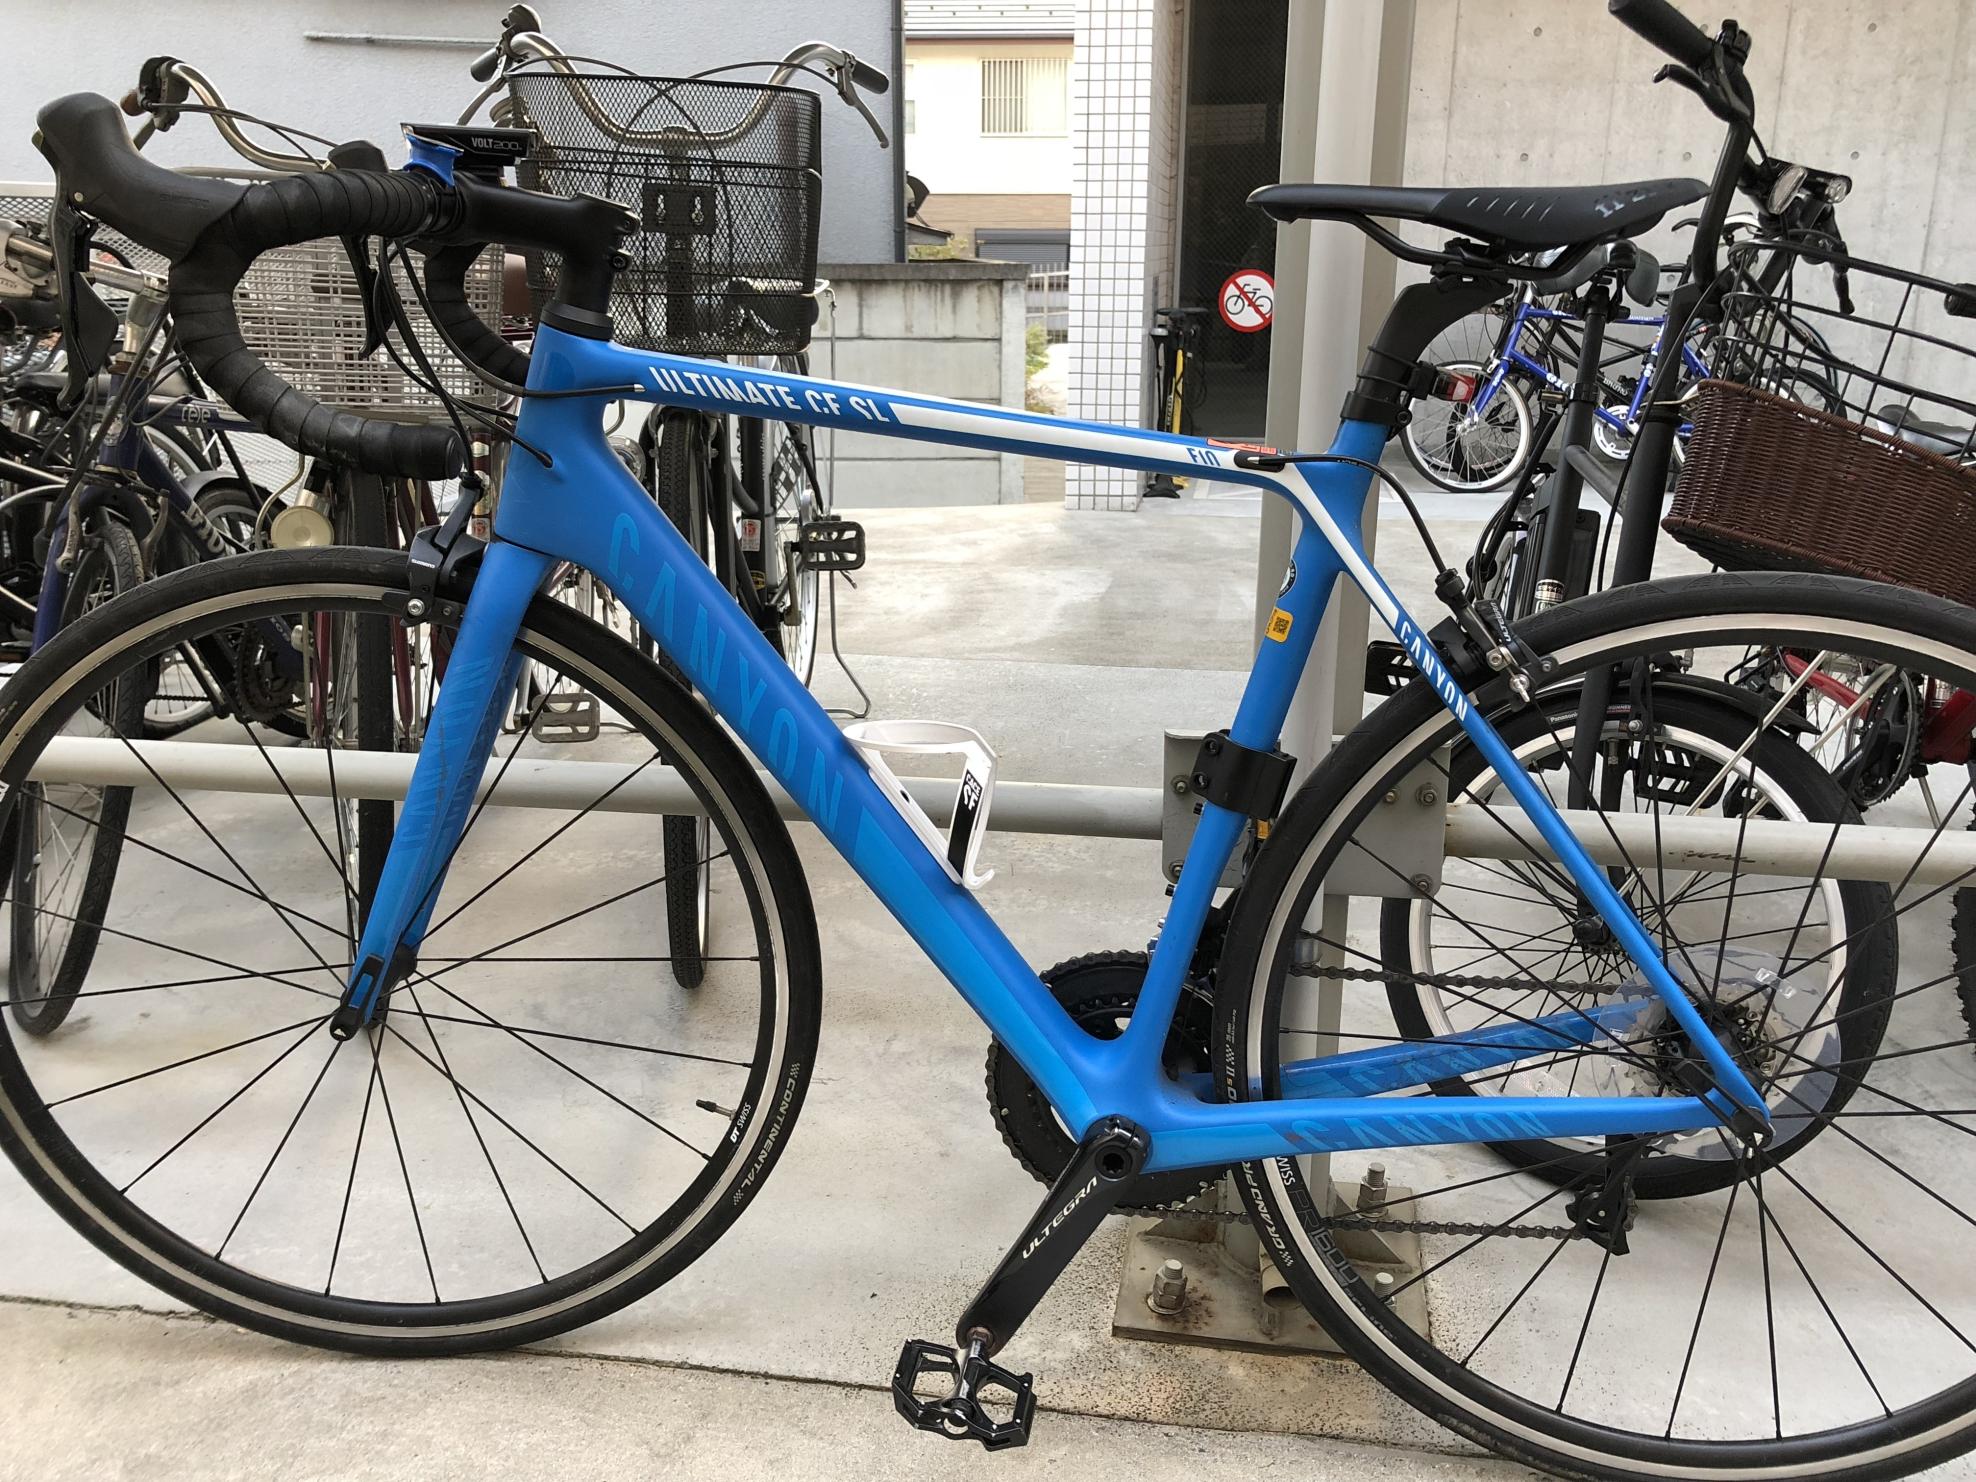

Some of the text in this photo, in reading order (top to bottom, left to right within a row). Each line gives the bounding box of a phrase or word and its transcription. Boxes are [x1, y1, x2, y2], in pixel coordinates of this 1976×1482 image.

[649, 366, 891, 423] ULTIMATE CF SL
[1490, 601, 1512, 643] ULTEGRA
[607, 513, 845, 834] CANYON
[1400, 620, 1468, 722] CANYON
[729, 1102, 753, 1144] DT SWISS
[741, 1077, 796, 1189] CONTINENTAL
[1291, 1110, 1552, 1152] CANYON
[1276, 1156, 1296, 1186] WISS
[1022, 1176, 1098, 1259] ULTEGRA
[1252, 1189, 1287, 1250] GRAND
